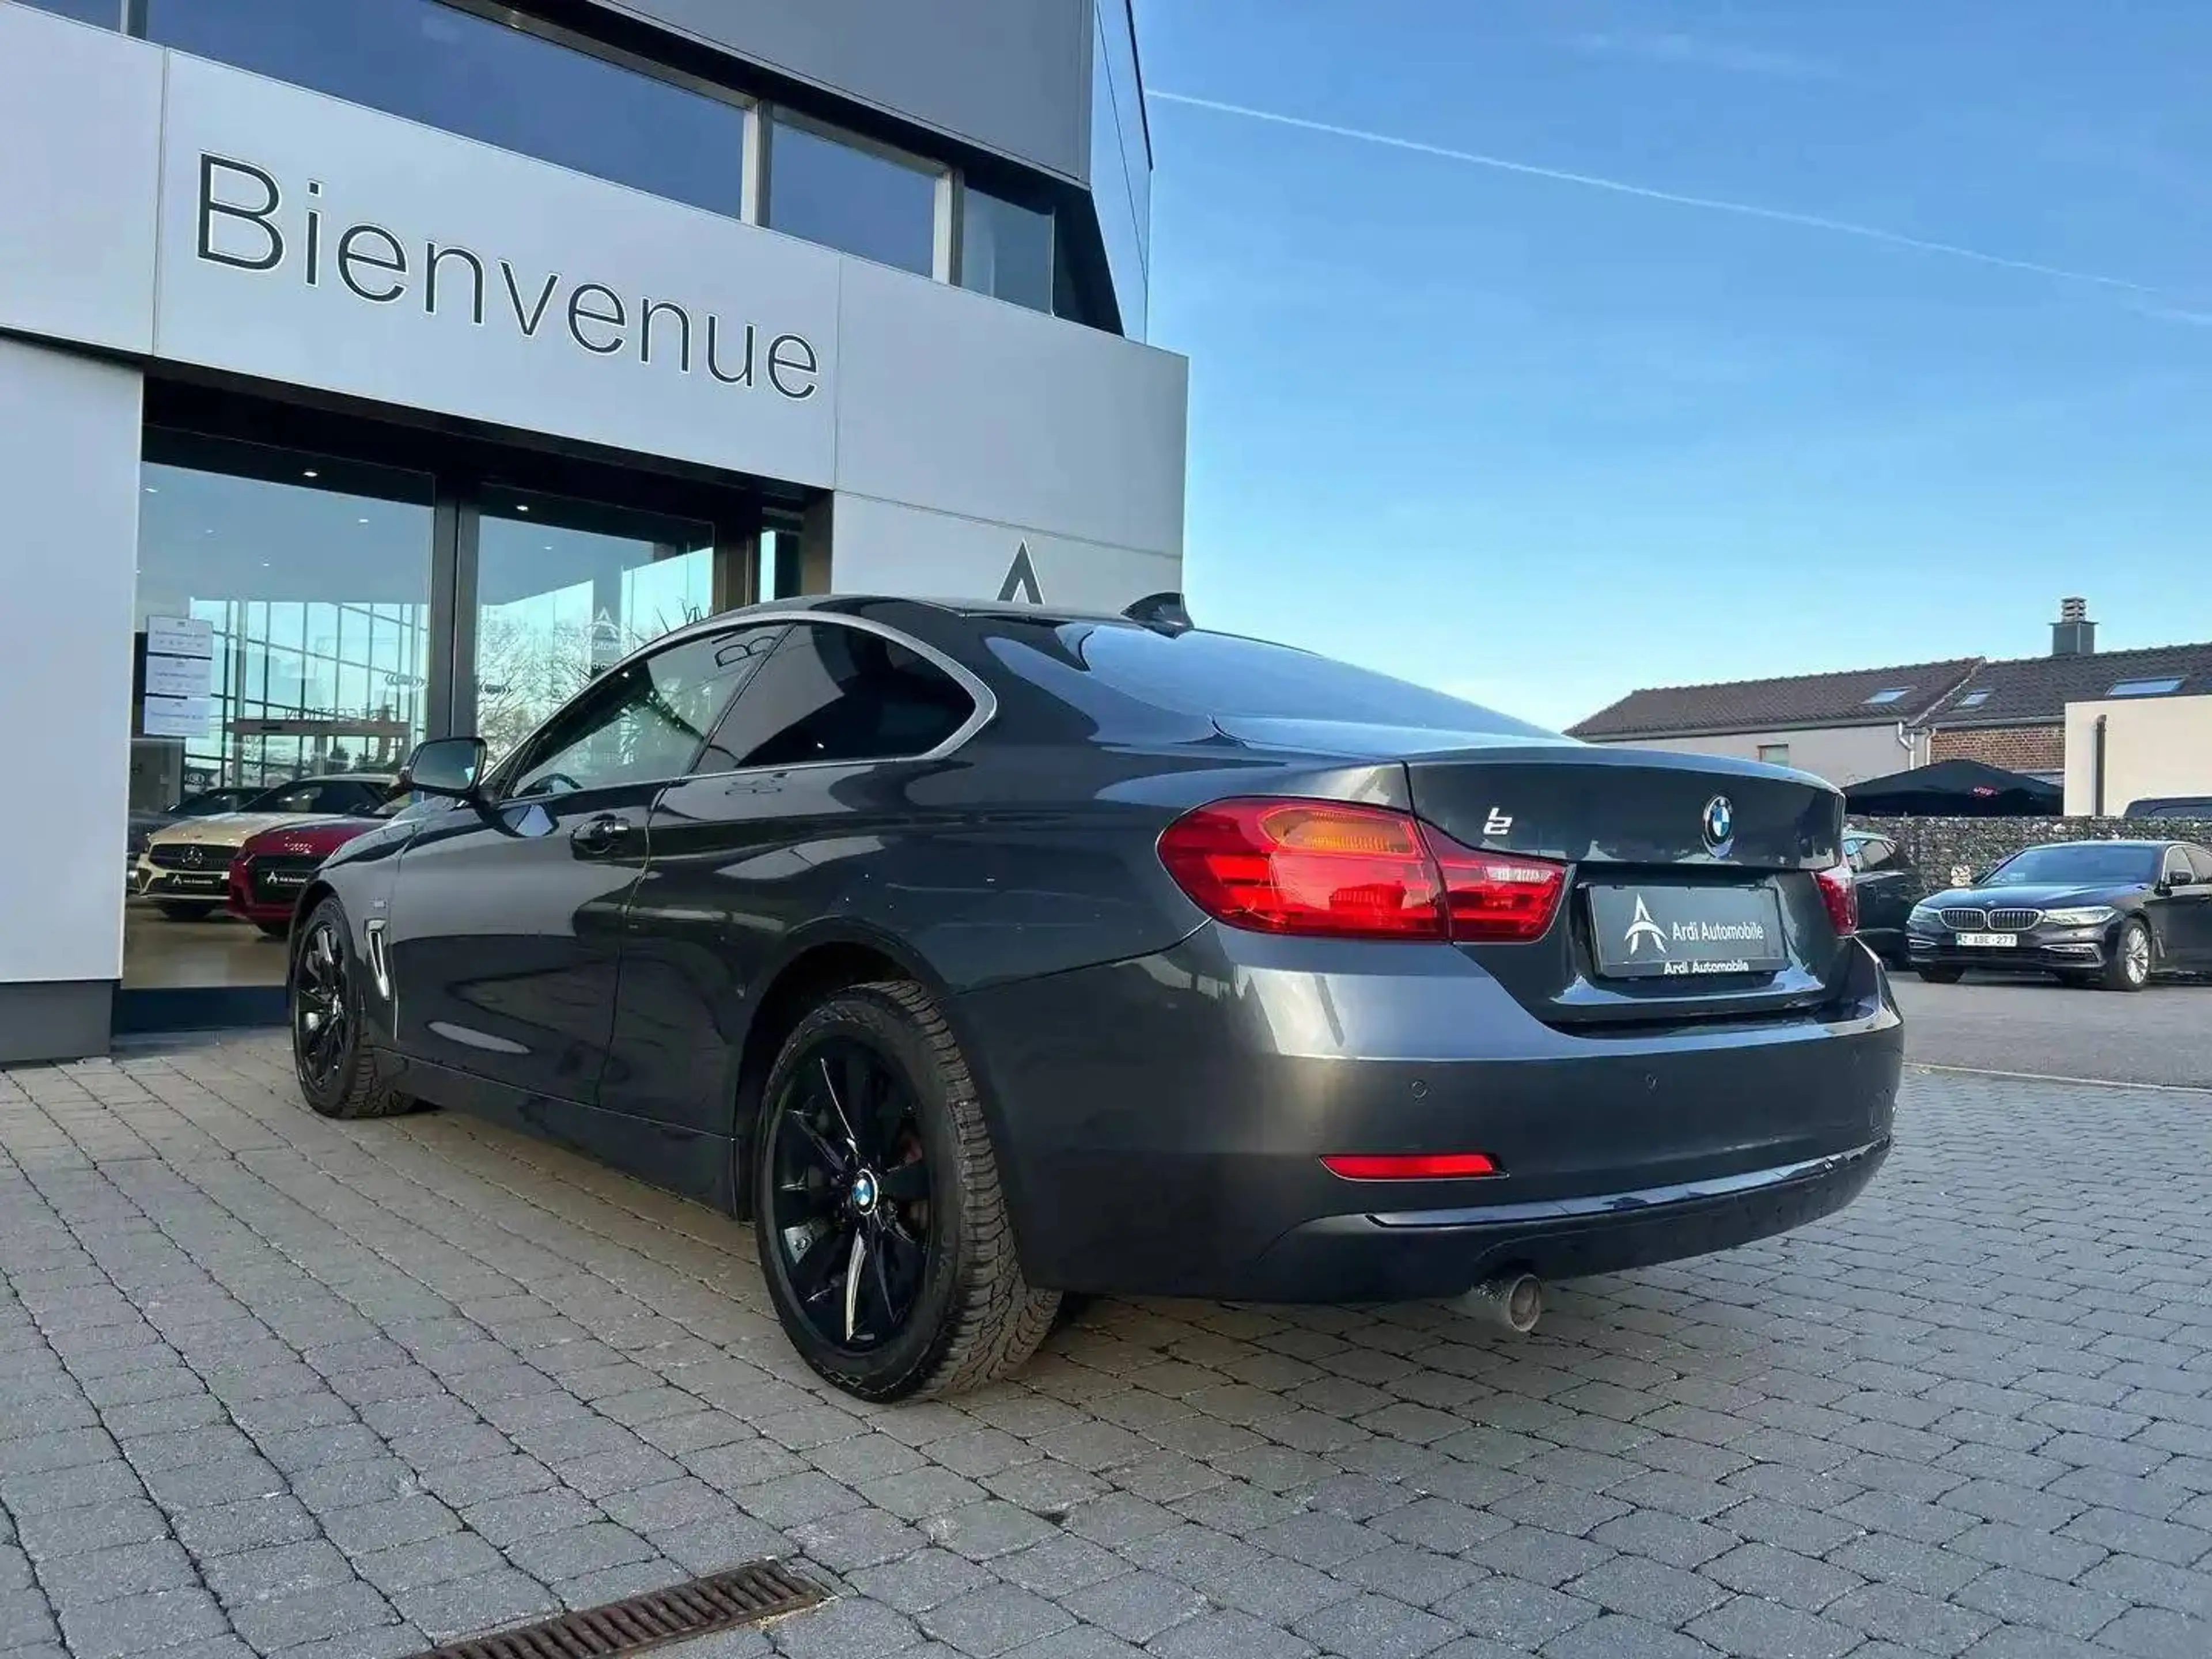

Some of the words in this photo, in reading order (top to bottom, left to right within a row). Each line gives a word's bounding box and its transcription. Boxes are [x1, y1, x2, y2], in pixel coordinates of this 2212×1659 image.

[197, 152, 819, 401] Bienvenue
[1673, 922, 1699, 941] Ardi
[1702, 922, 1764, 940] Automobile
[1664, 961, 1688, 975] Ardi
[1692, 959, 1749, 974] Automobile
